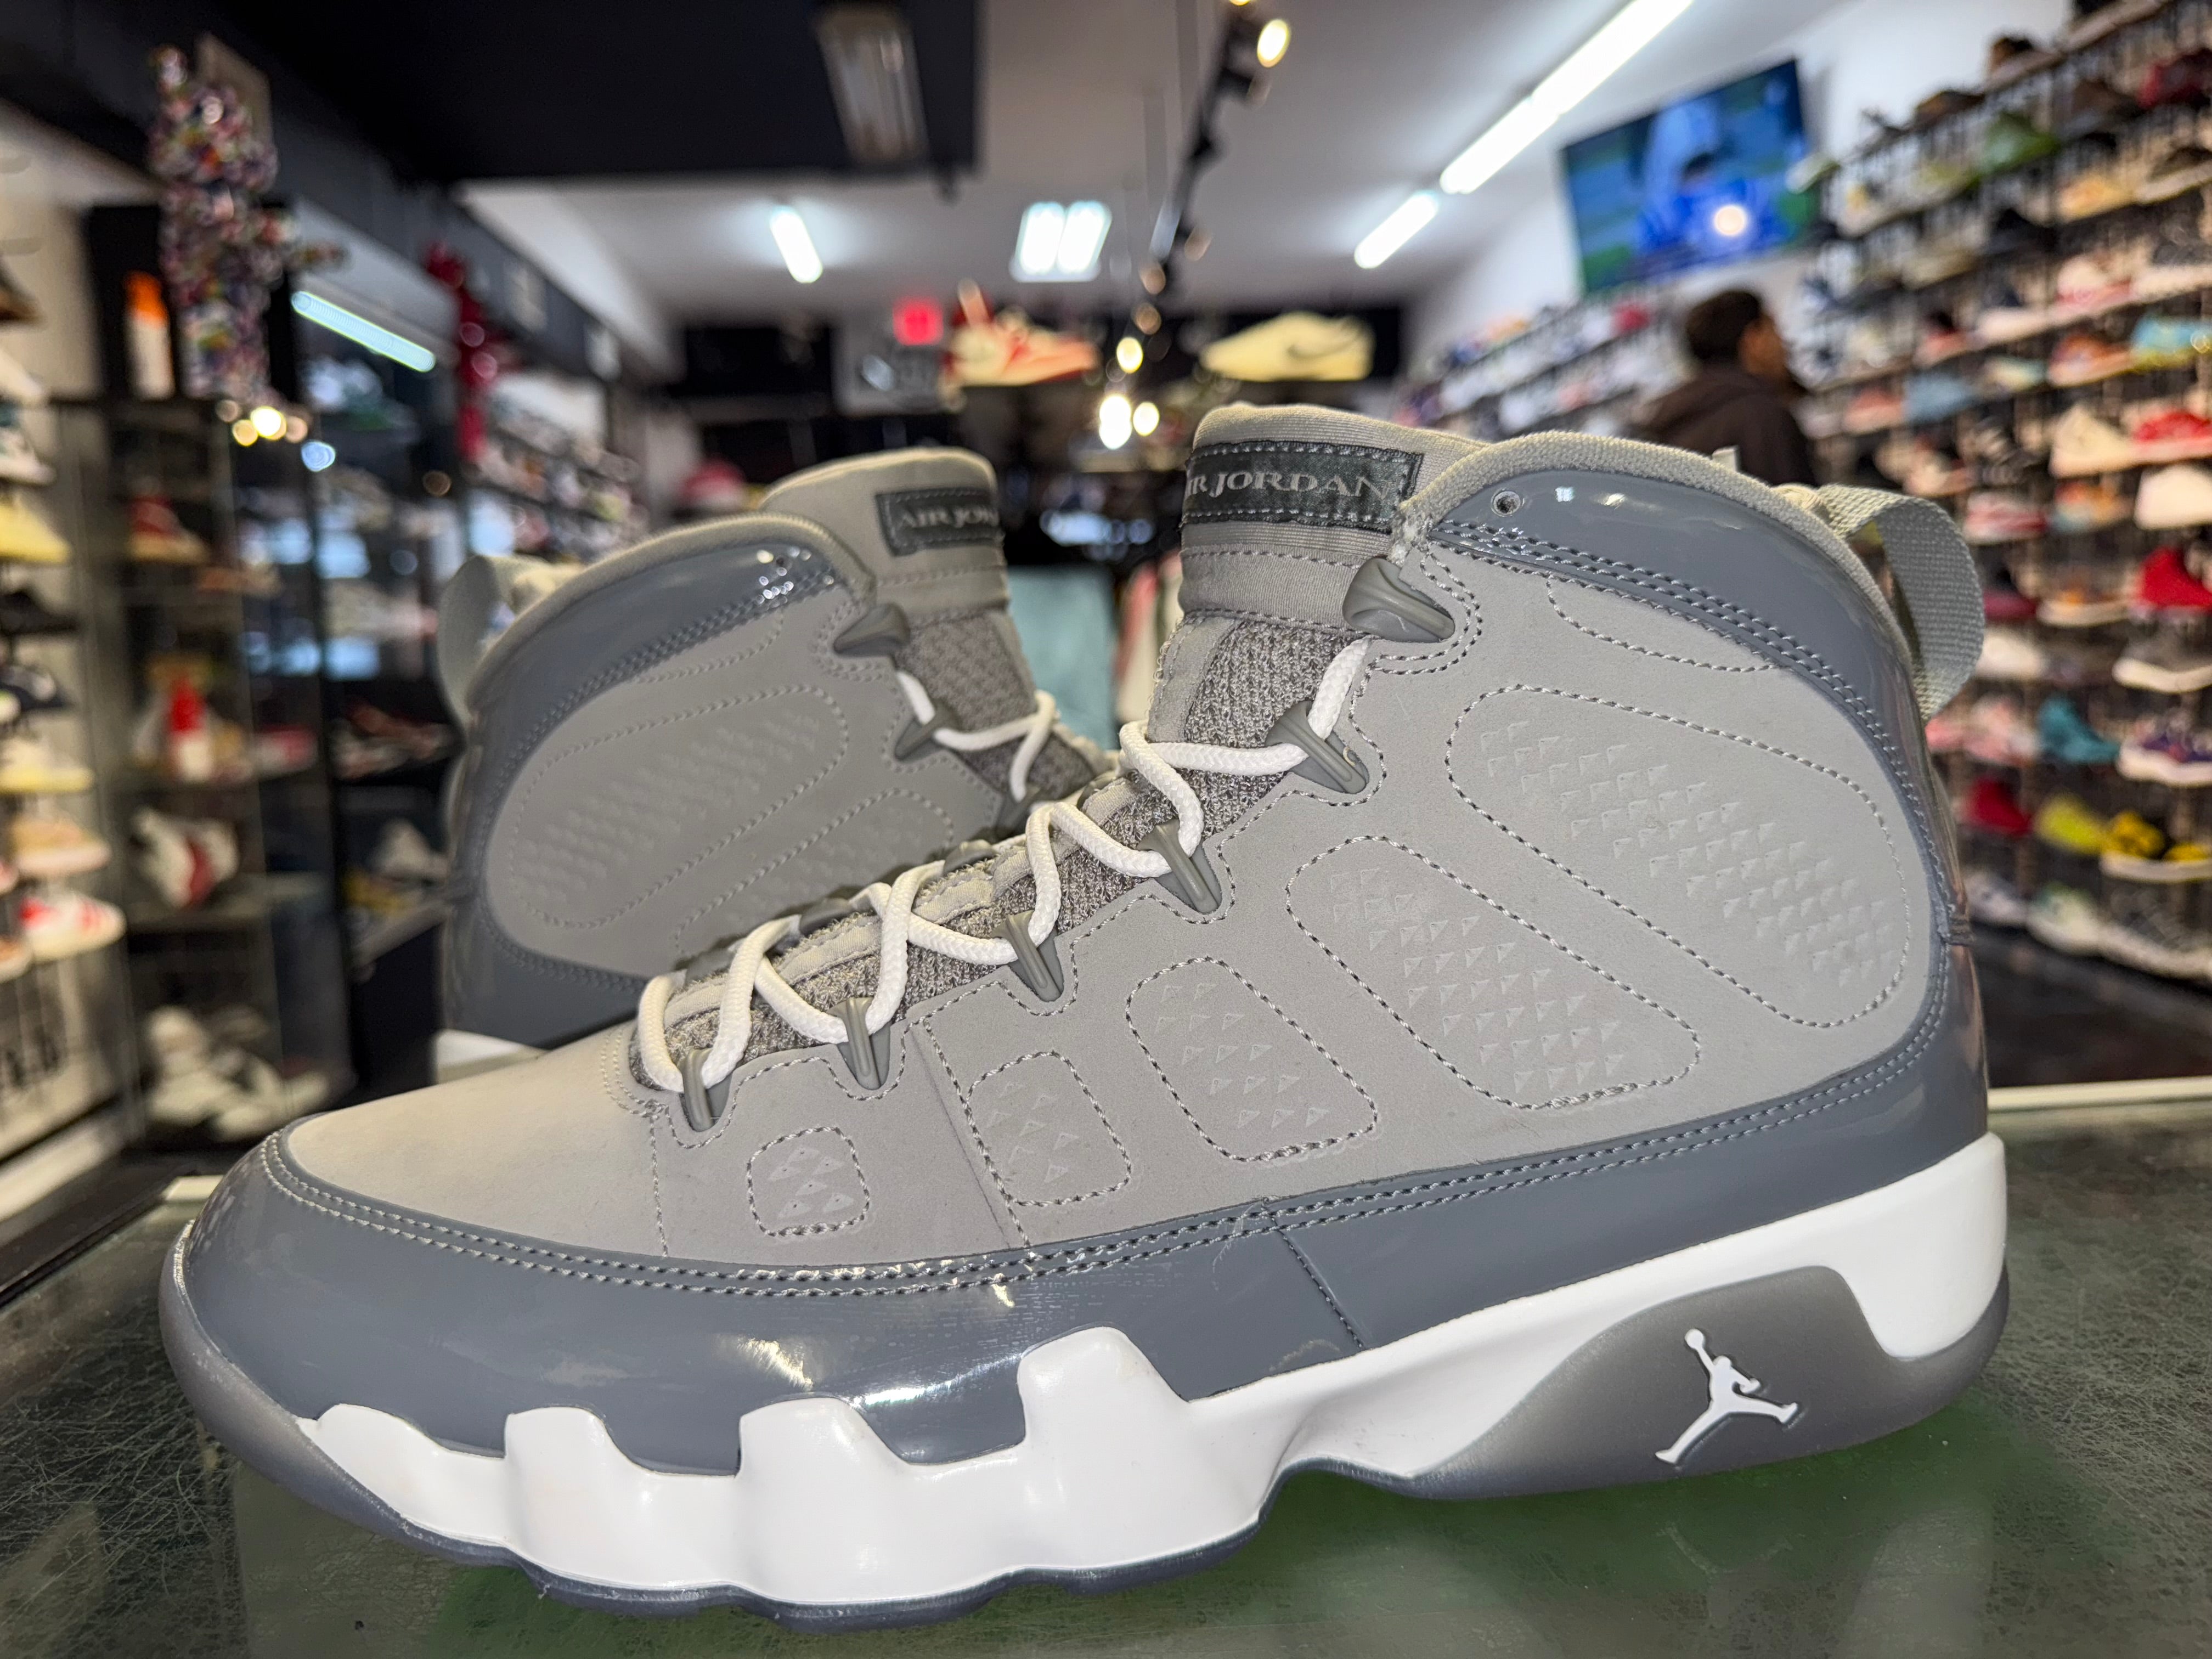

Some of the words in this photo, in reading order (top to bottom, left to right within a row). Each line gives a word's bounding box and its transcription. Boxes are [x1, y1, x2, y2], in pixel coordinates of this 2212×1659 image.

[1183, 475, 1208, 498] IR
[1209, 470, 1393, 499] JORDAN
[896, 507, 949, 528] AIR
